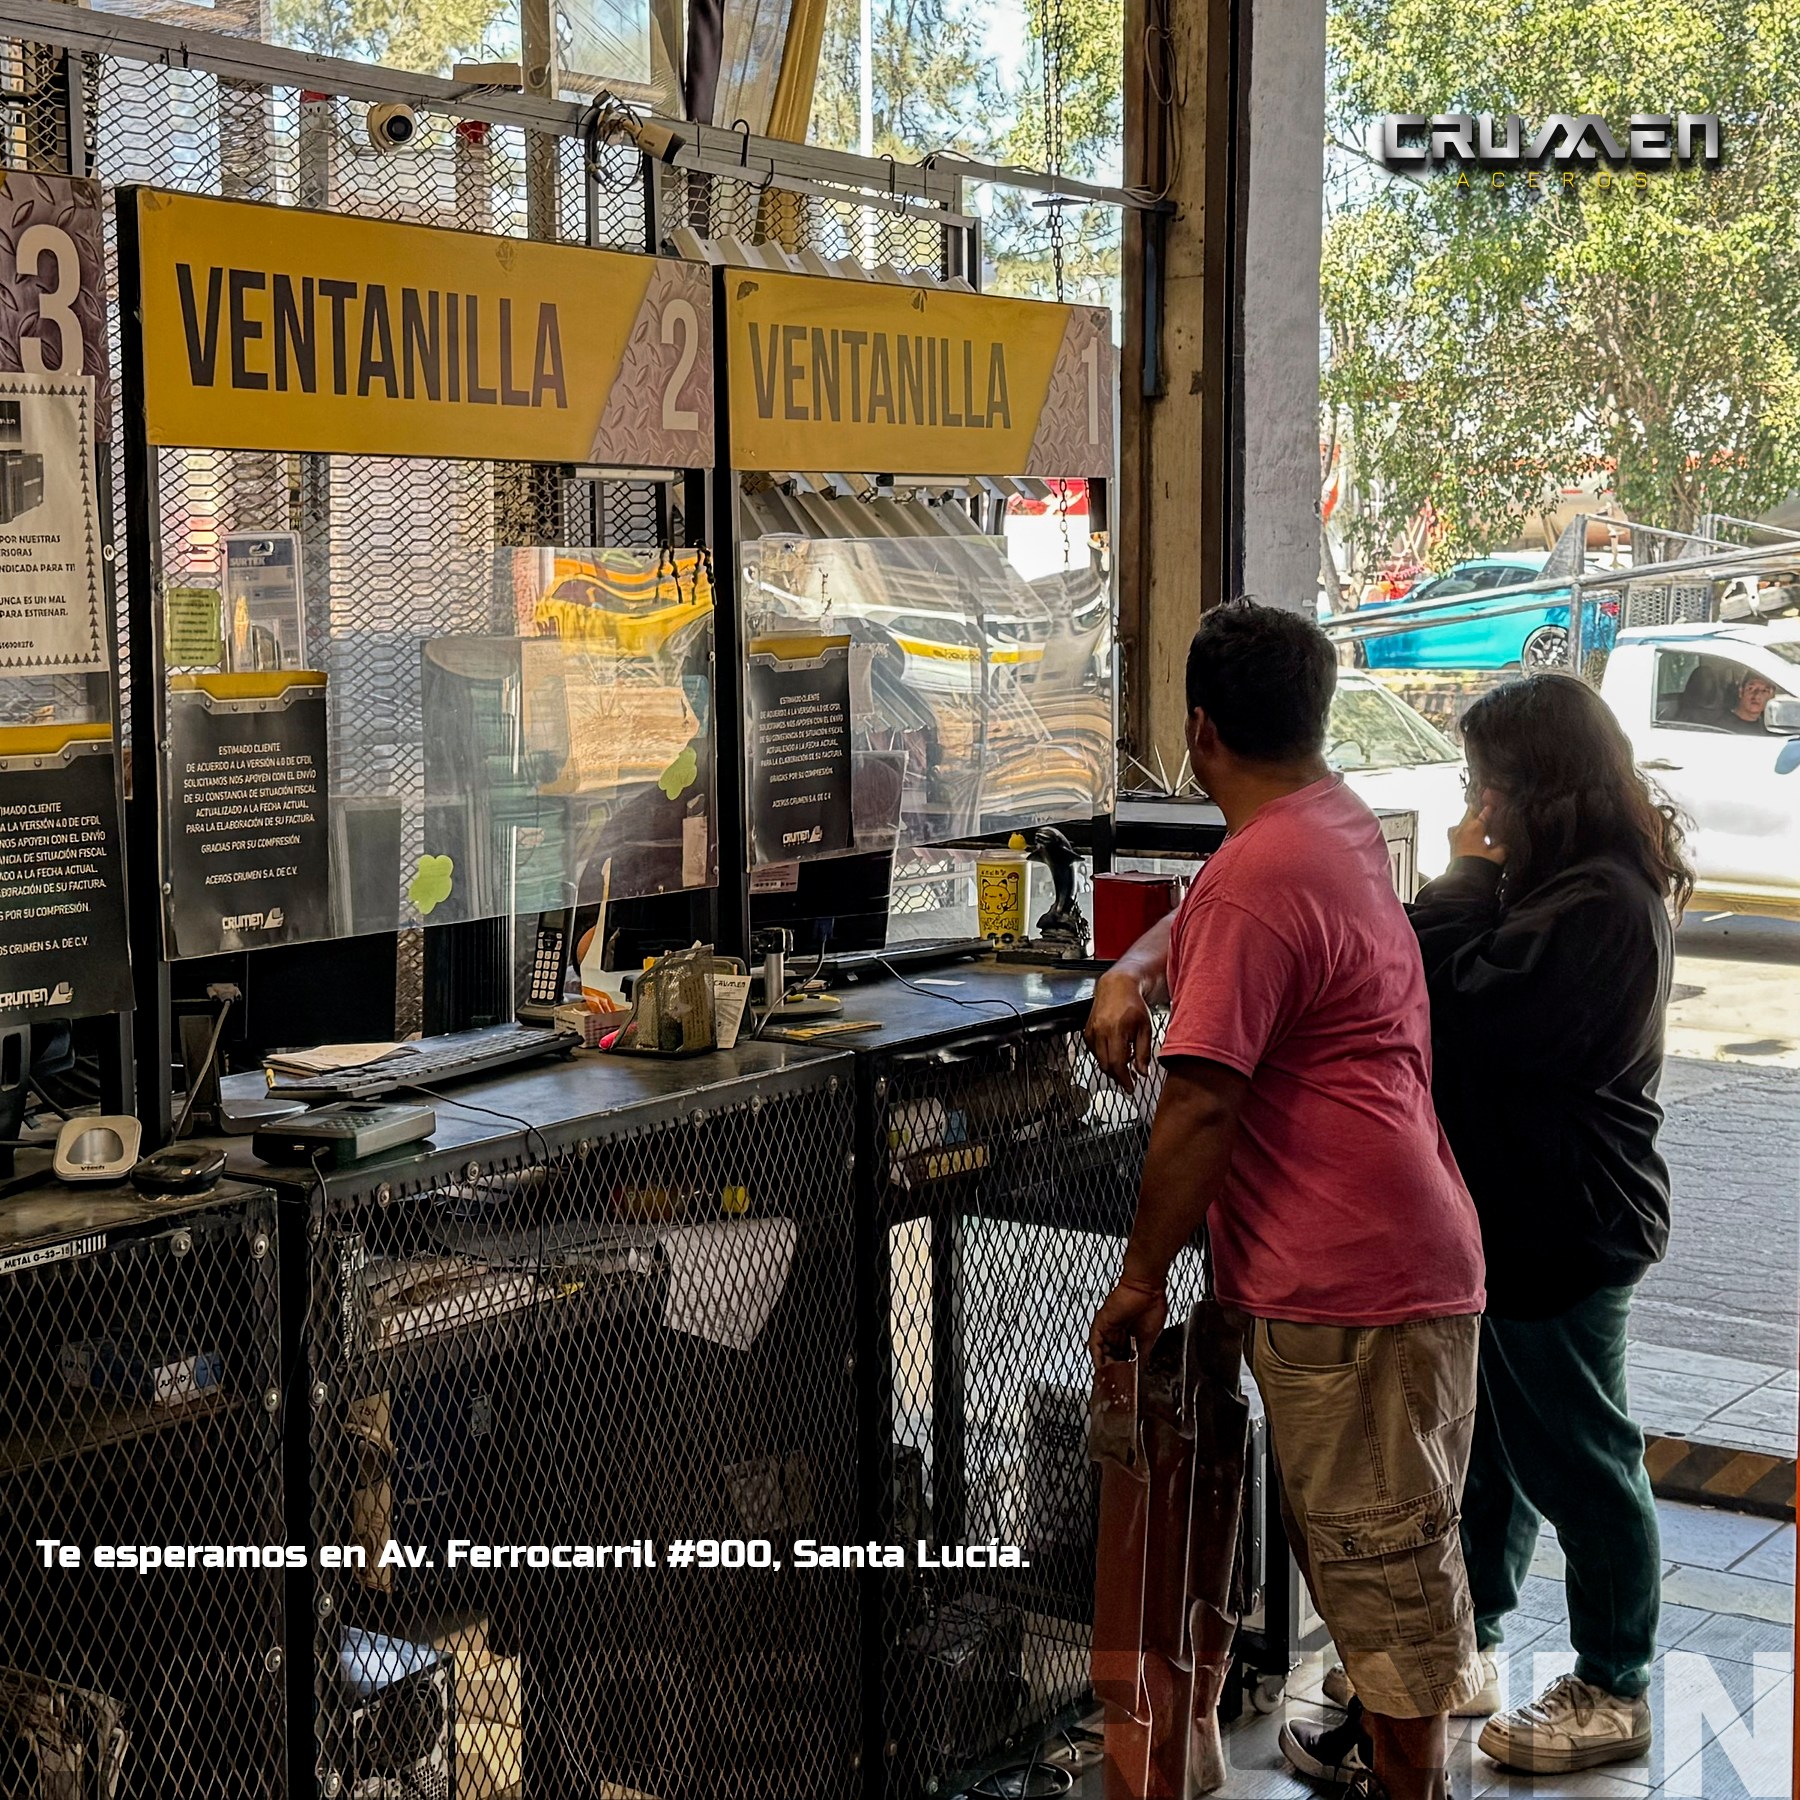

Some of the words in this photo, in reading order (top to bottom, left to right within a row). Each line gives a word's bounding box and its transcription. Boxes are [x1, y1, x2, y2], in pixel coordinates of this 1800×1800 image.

[16, 224, 84, 375] 3
[175, 263, 568, 408] VENTANILLA
[660, 299, 699, 431] 2
[748, 322, 1011, 429] VENTANILLA
[1081, 336, 1098, 445] 1
[19, 535, 61, 544] NUESTRAS
[40, 563, 63, 572] PARA
[24, 595, 33, 604] ES
[34, 595, 47, 604] UN
[48, 595, 66, 604] MAL
[0, 609, 23, 618] PARA
[254, 742, 281, 753] CLIENTE
[186, 763, 196, 773] DE
[197, 761, 229, 772] ACUERDO
[236, 760, 246, 769] LA
[286, 756, 296, 766] DE
[184, 776, 228, 788] SOLICITAMOS
[229, 775, 244, 785] NOS
[272, 771, 286, 781] CON
[287, 771, 295, 780] EL
[184, 794, 194, 804] DE
[194, 793, 204, 802] SU
[205, 790, 247, 801] CONSTANCIA
[28, 802, 62, 814] CLIENTE
[249, 803, 259, 813] LA
[8, 822, 19, 832] LA
[20, 817, 55, 831] VERSIÓN
[69, 817, 80, 827] DE
[186, 823, 204, 834] PARA
[206, 822, 215, 832] LA
[264, 817, 273, 826] DE
[275, 816, 284, 825] SU
[0, 838, 17, 849] NOS
[17, 836, 50, 848] APOYEN
[51, 834, 68, 845] CON
[69, 833, 79, 843] EL
[81, 829, 106, 842] ENVÍO
[201, 842, 231, 854] GRACIAS
[232, 840, 246, 850] POR
[247, 839, 256, 849] SU
[23, 853, 35, 863] DE
[36, 848, 77, 862] SITUACIÓN
[78, 847, 107, 858] FISCAL
[17, 870, 23, 880] A
[24, 869, 35, 879] LA
[36, 867, 63, 878] FECHA
[205, 873, 232, 885] ACEROS
[233, 870, 262, 882] CRUMEN
[276, 867, 286, 877] DE
[43, 883, 55, 894] DE
[56, 882, 68, 893] SU
[5, 909, 22, 920] POR
[23, 907, 35, 919] SU
[222, 912, 264, 930] CRUMEN
[9, 941, 44, 955] CRUMEN
[62, 937, 74, 949] DE
[0, 987, 48, 1008] CRUMEN
[4, 1256, 31, 1269] METAL
